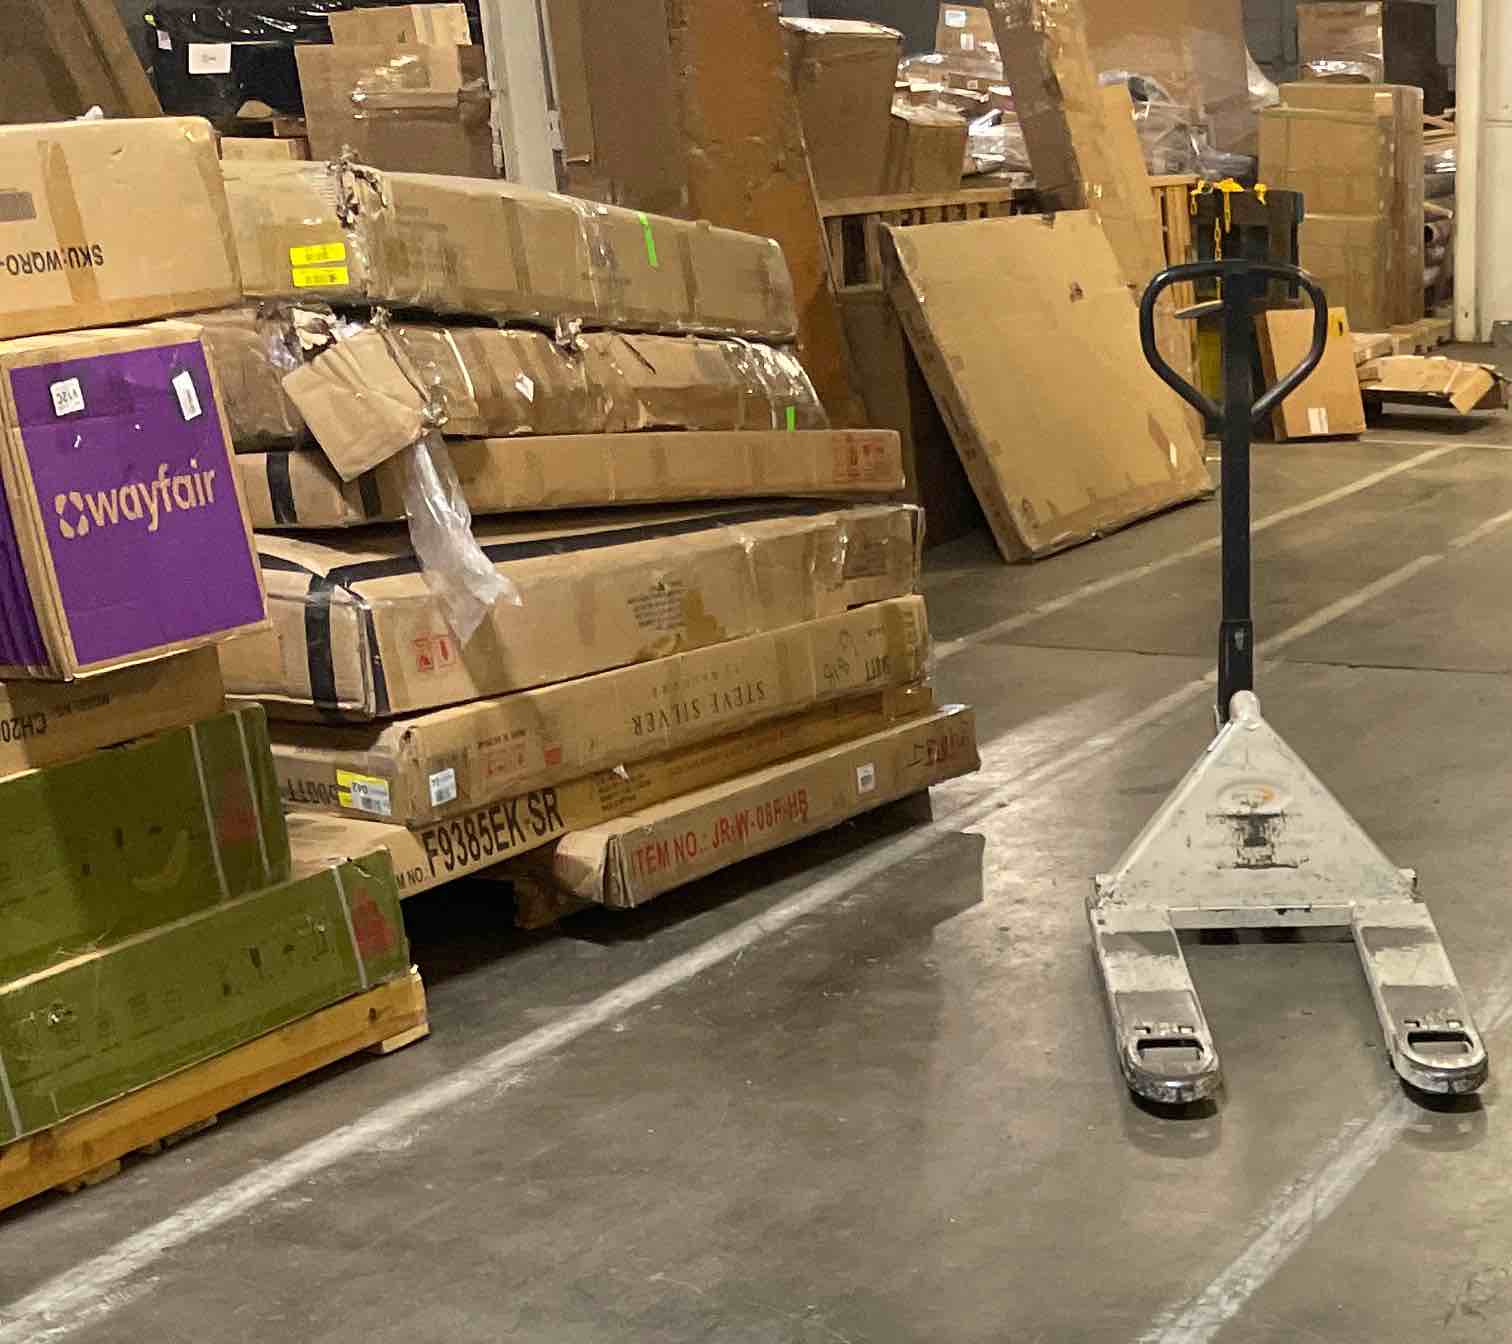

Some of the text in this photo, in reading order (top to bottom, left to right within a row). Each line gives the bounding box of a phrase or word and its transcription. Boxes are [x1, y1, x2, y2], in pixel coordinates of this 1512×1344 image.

[84, 458, 215, 531] wayfair
[631, 680, 766, 737] STEVE SILVER
